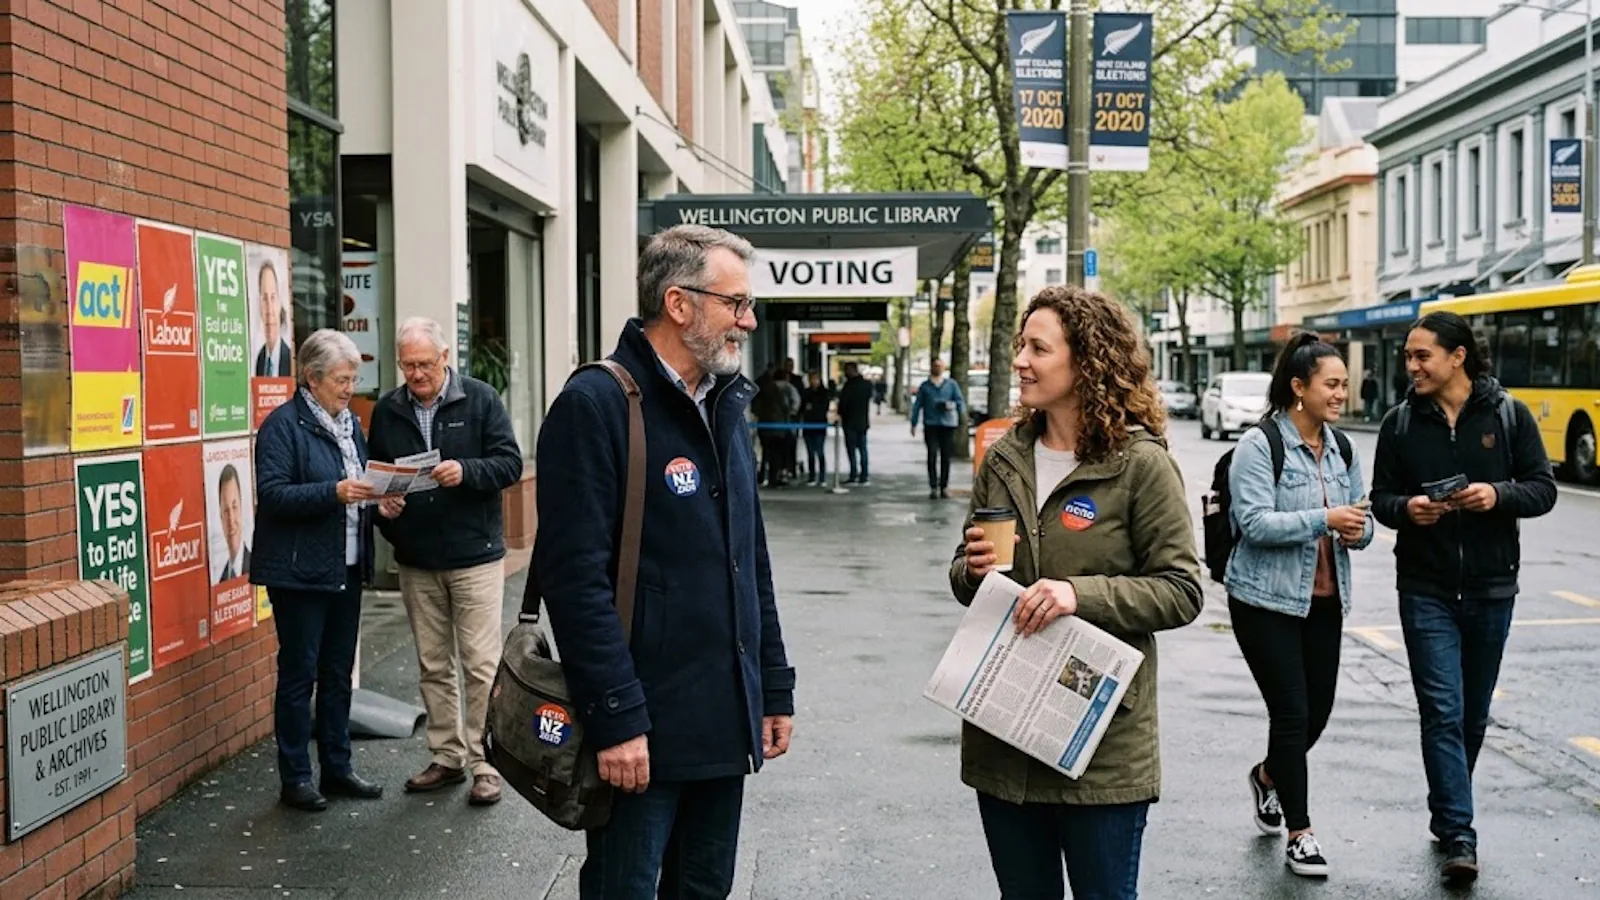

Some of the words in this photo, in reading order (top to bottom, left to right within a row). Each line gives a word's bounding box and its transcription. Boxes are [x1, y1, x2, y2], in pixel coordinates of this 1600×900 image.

[1019, 90, 1035, 105] 17
[1038, 91, 1063, 106] OCT
[1096, 93, 1113, 107] 17
[1116, 93, 1145, 108] OCT
[1020, 107, 1064, 129] 2020
[1095, 110, 1145, 132] 2020
[679, 208, 807, 226] WELLINGTON
[812, 207, 878, 225] PUBLIC
[884, 206, 961, 224] LIBRARY
[202, 254, 239, 297] YES
[769, 259, 894, 285] VOTING
[79, 274, 121, 319] act
[149, 318, 192, 346] Labour
[206, 337, 243, 363] Choice
[83, 481, 138, 532] YES
[87, 541, 105, 567] to
[108, 531, 136, 563] End
[155, 538, 201, 568] Labour
[28, 669, 110, 720] WELLINGTON
[20, 716, 67, 757] PUBLIC
[70, 695, 117, 735] LIBRARY
[539, 715, 565, 736] NZ
[35, 759, 46, 781] &
[49, 728, 108, 777] ARCHIVES
[54, 776, 72, 798] EST.
